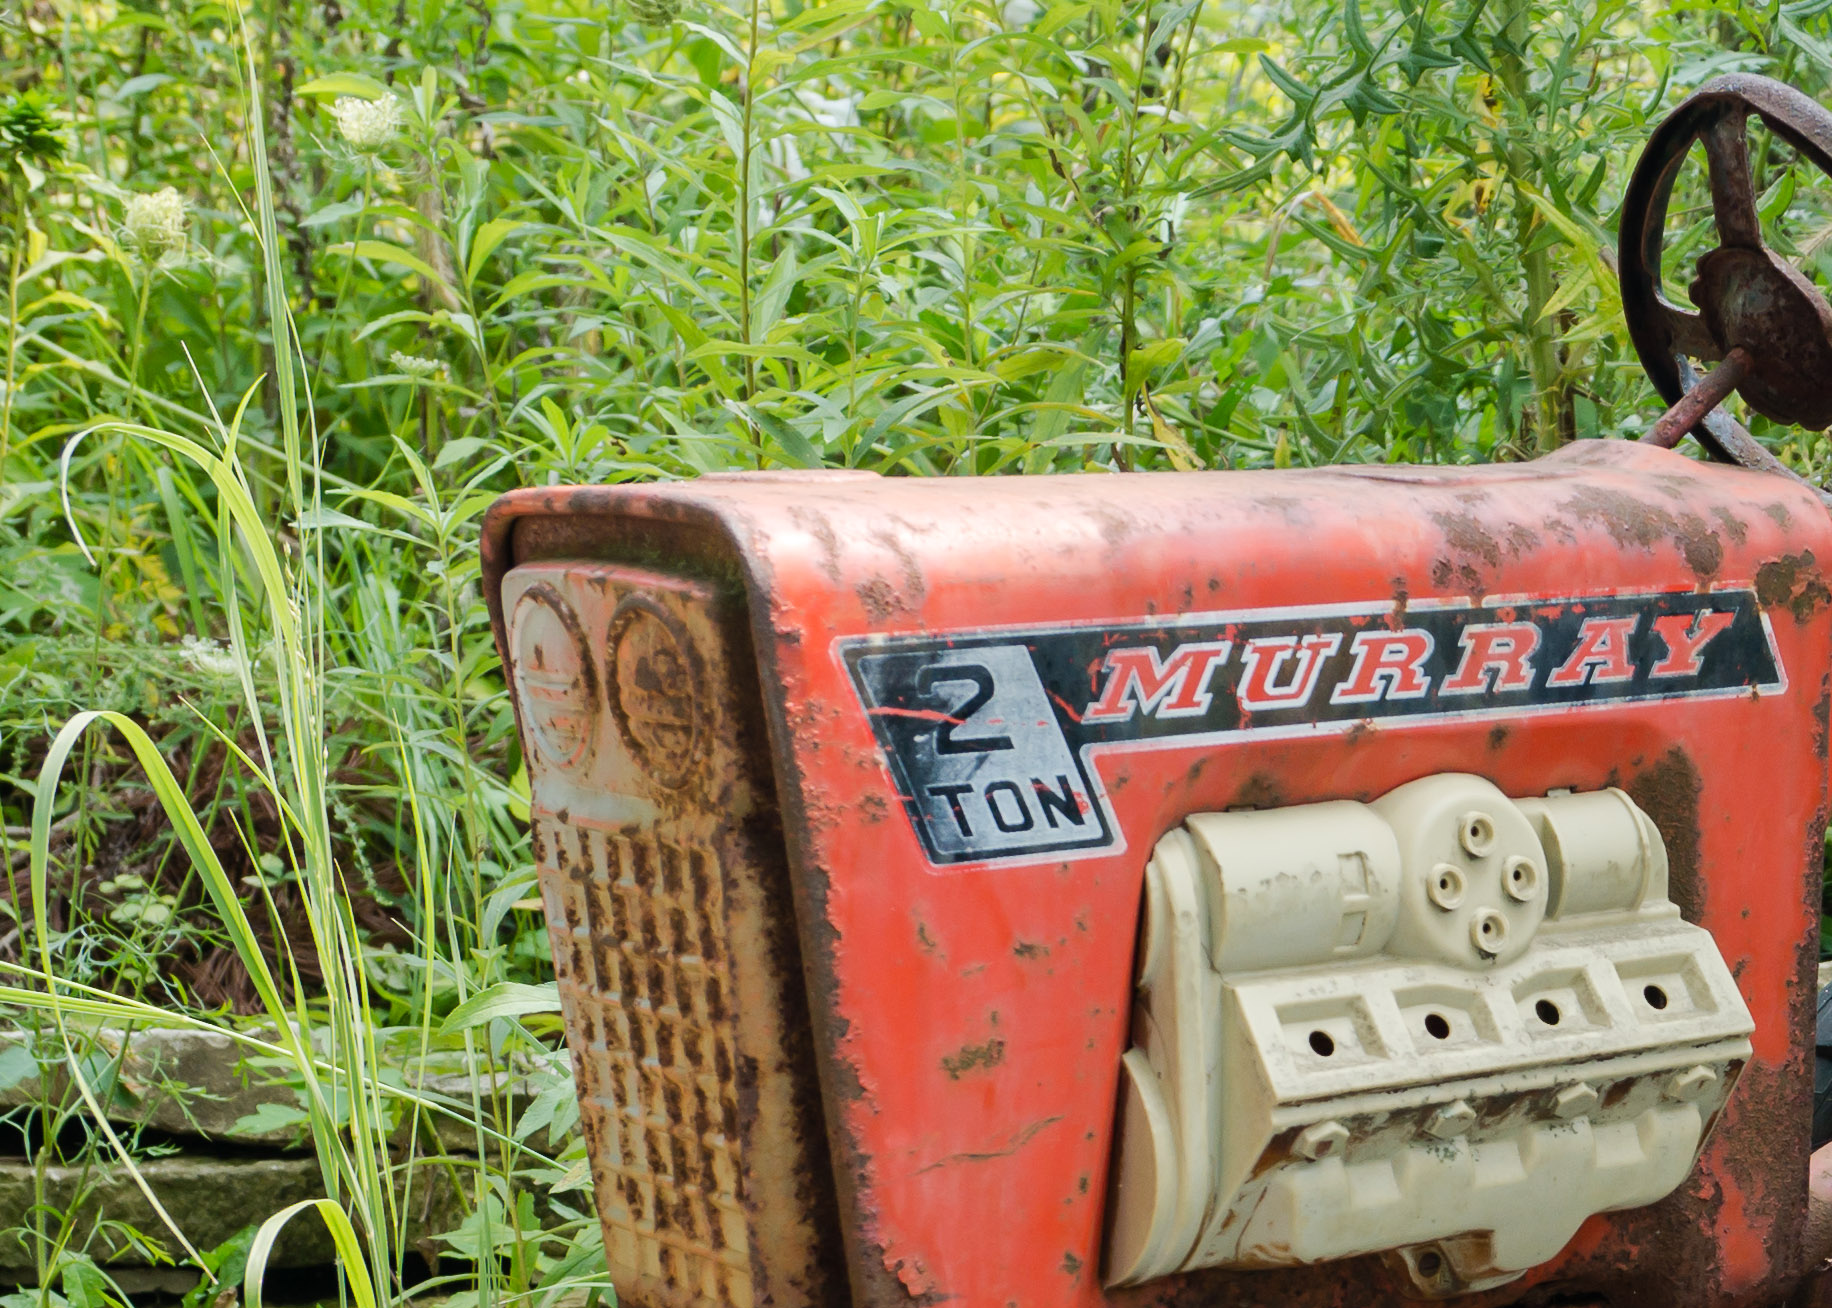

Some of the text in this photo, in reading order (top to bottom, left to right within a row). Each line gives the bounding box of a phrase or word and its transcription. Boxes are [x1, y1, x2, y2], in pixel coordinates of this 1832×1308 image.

[916, 664, 1015, 755] 2
[1081, 607, 1737, 724] MURRAY
[926, 774, 1087, 837] TON
